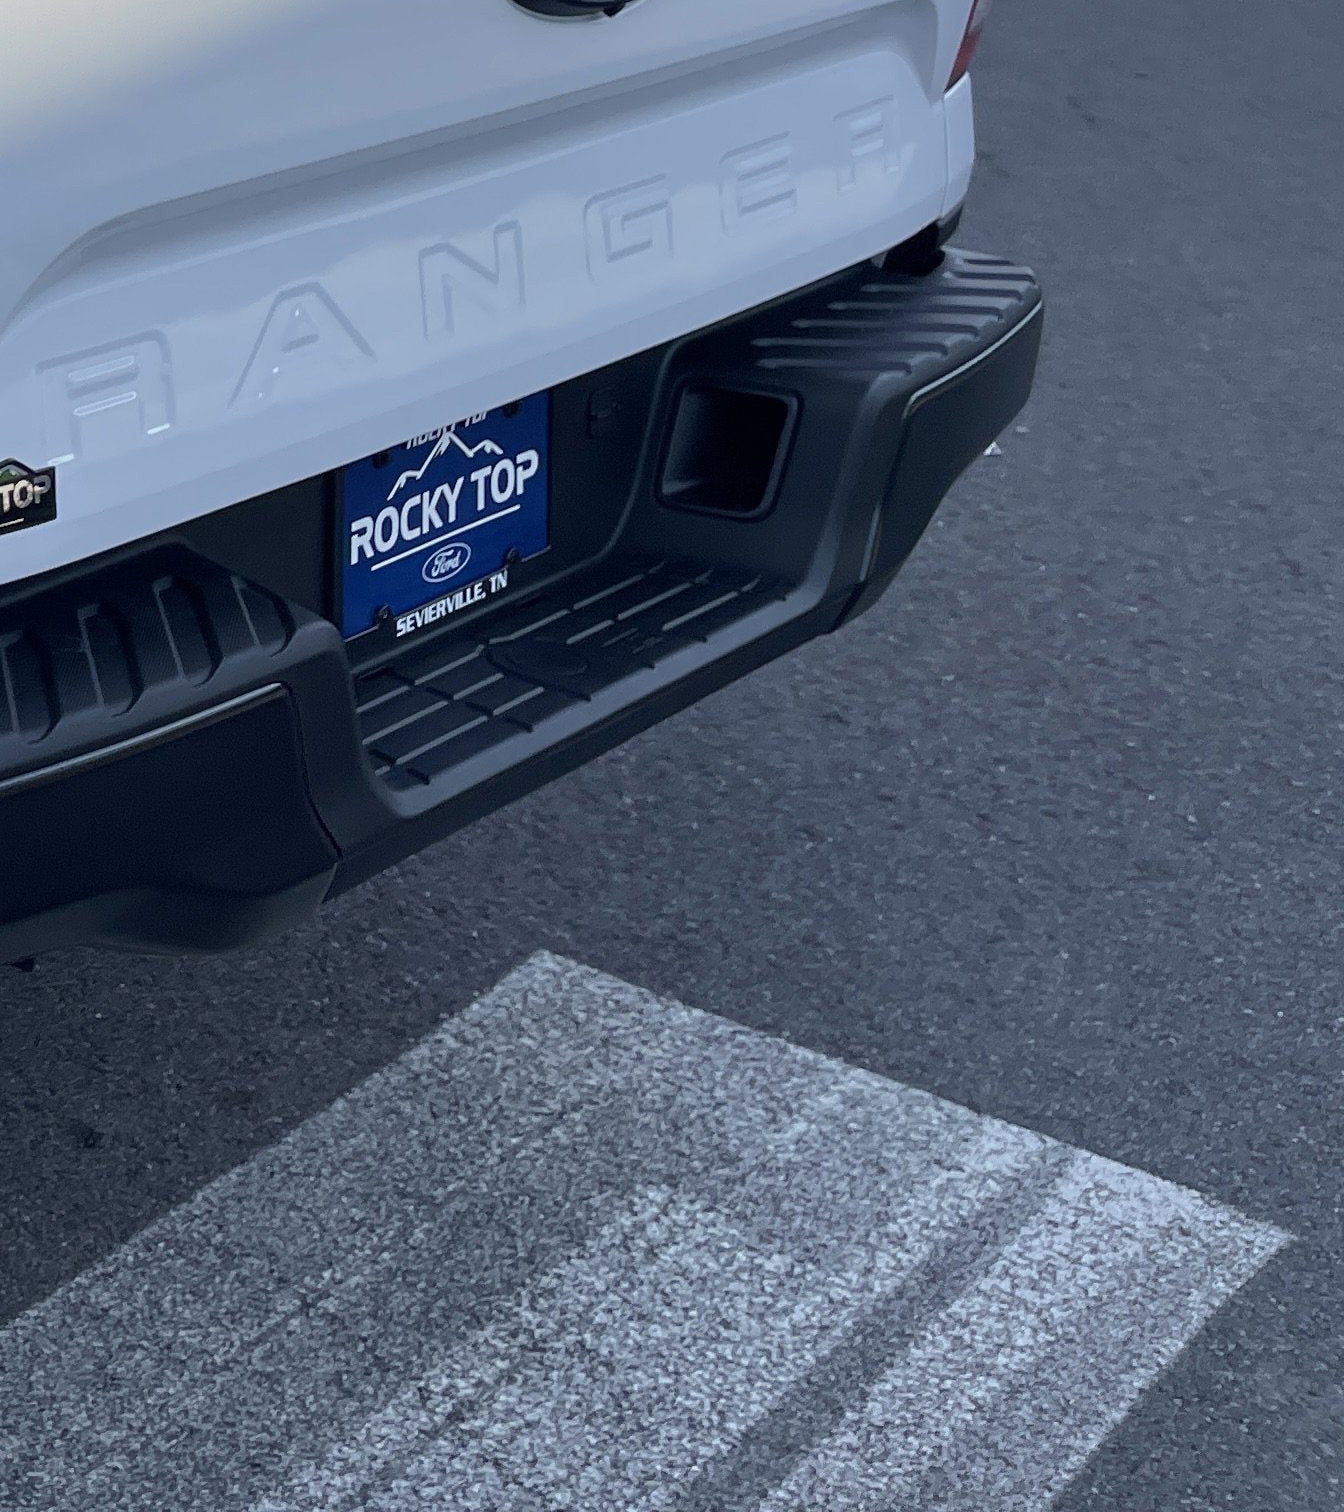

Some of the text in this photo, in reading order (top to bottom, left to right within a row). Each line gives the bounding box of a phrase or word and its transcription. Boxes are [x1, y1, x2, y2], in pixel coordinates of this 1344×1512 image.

[35, 93, 904, 466] RANGER
[350, 449, 540, 566] ROCKY TOP
[431, 547, 463, 578] Ford
[489, 569, 508, 593] TN
